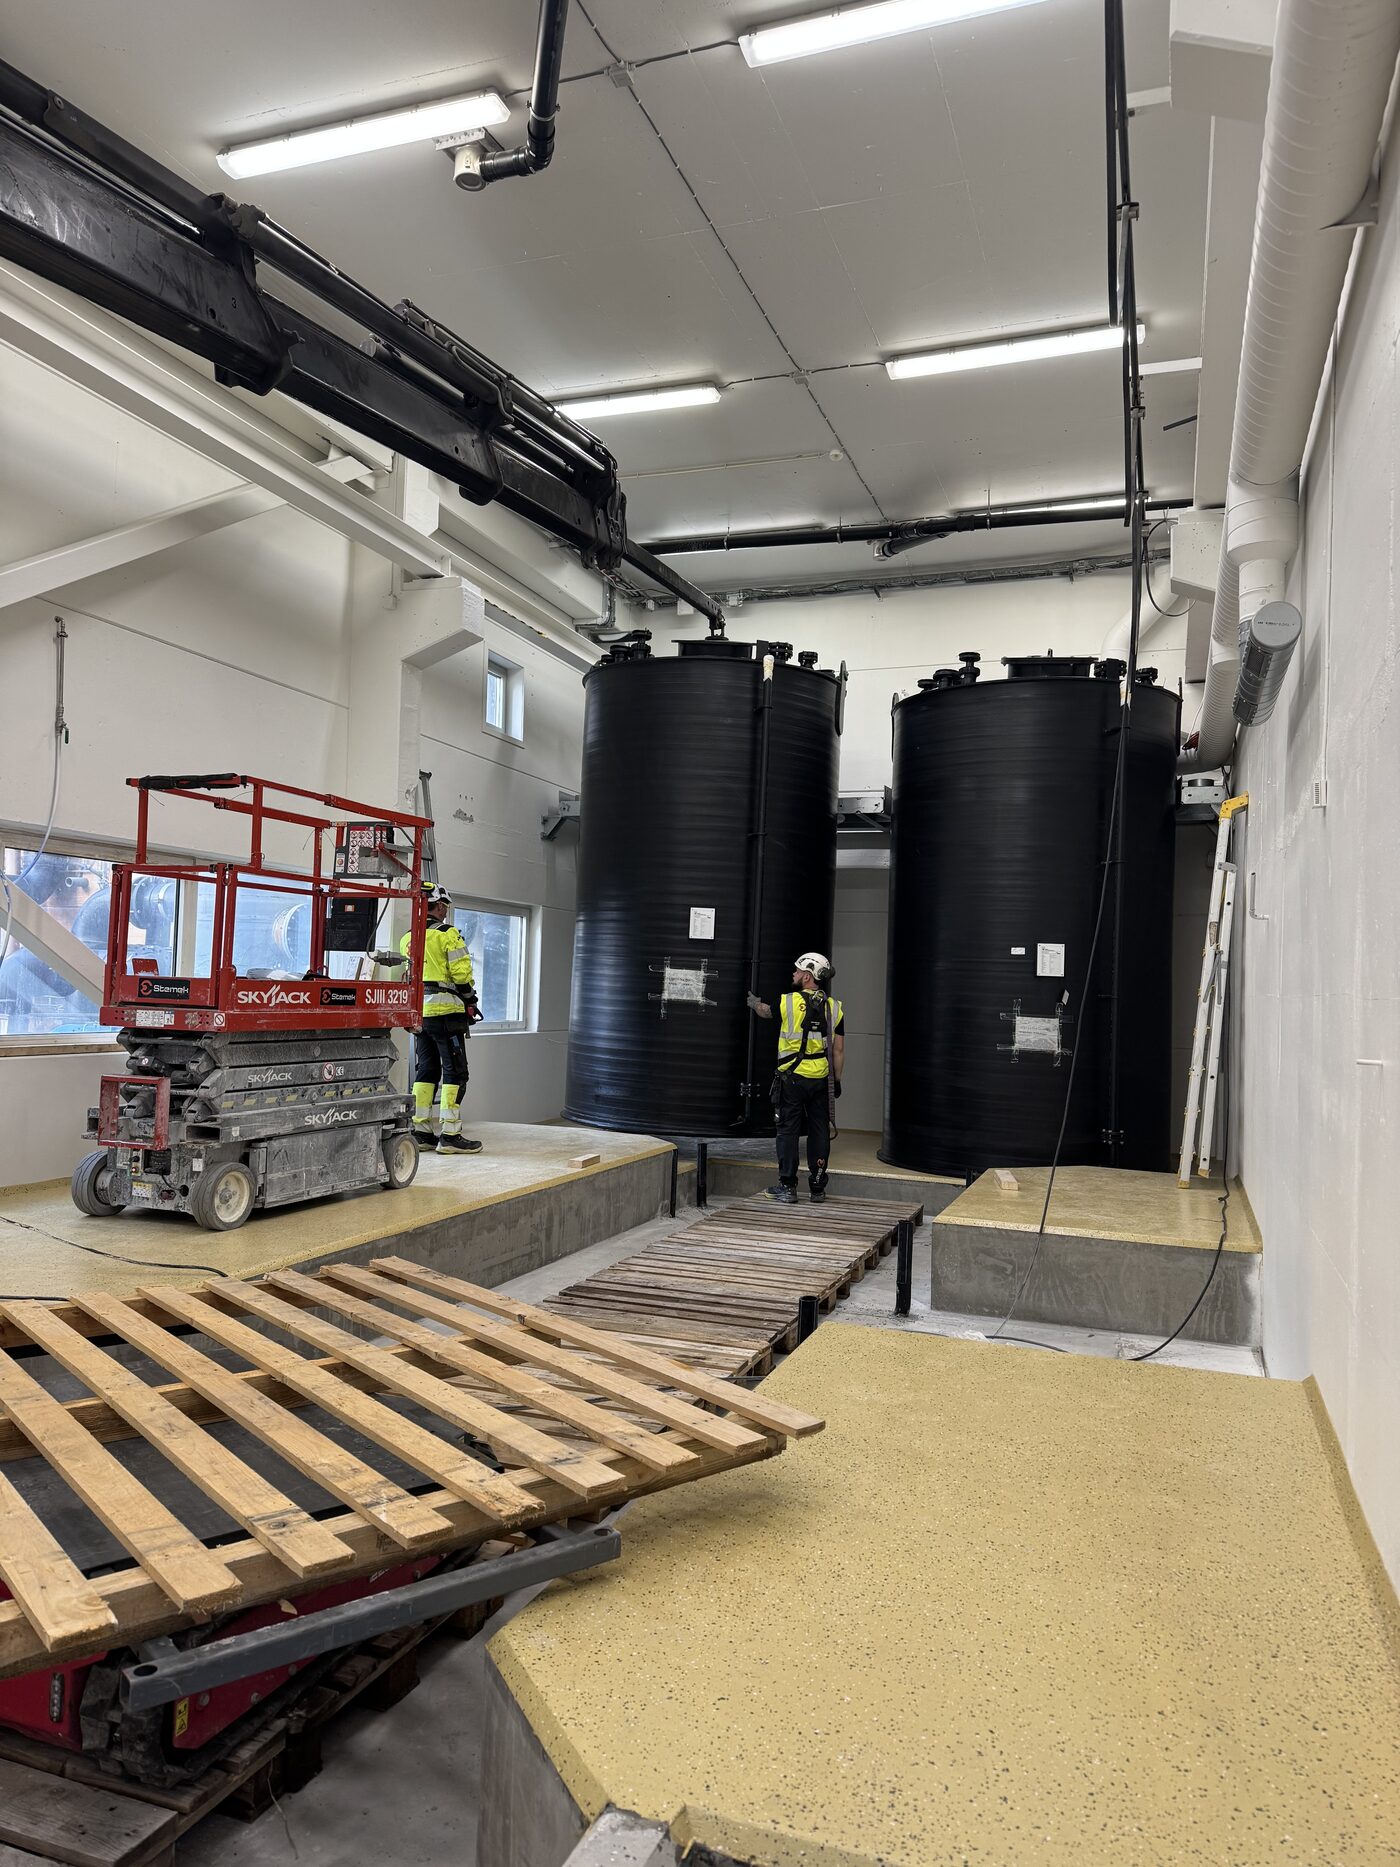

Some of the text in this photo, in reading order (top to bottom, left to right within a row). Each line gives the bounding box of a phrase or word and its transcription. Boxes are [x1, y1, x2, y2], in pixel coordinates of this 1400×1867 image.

[237, 984, 311, 1007] SKYJACK
[365, 988, 408, 1004] SJIII 3219
[247, 1068, 292, 1083] SKYJACK
[304, 1107, 358, 1126] SKYJACK
